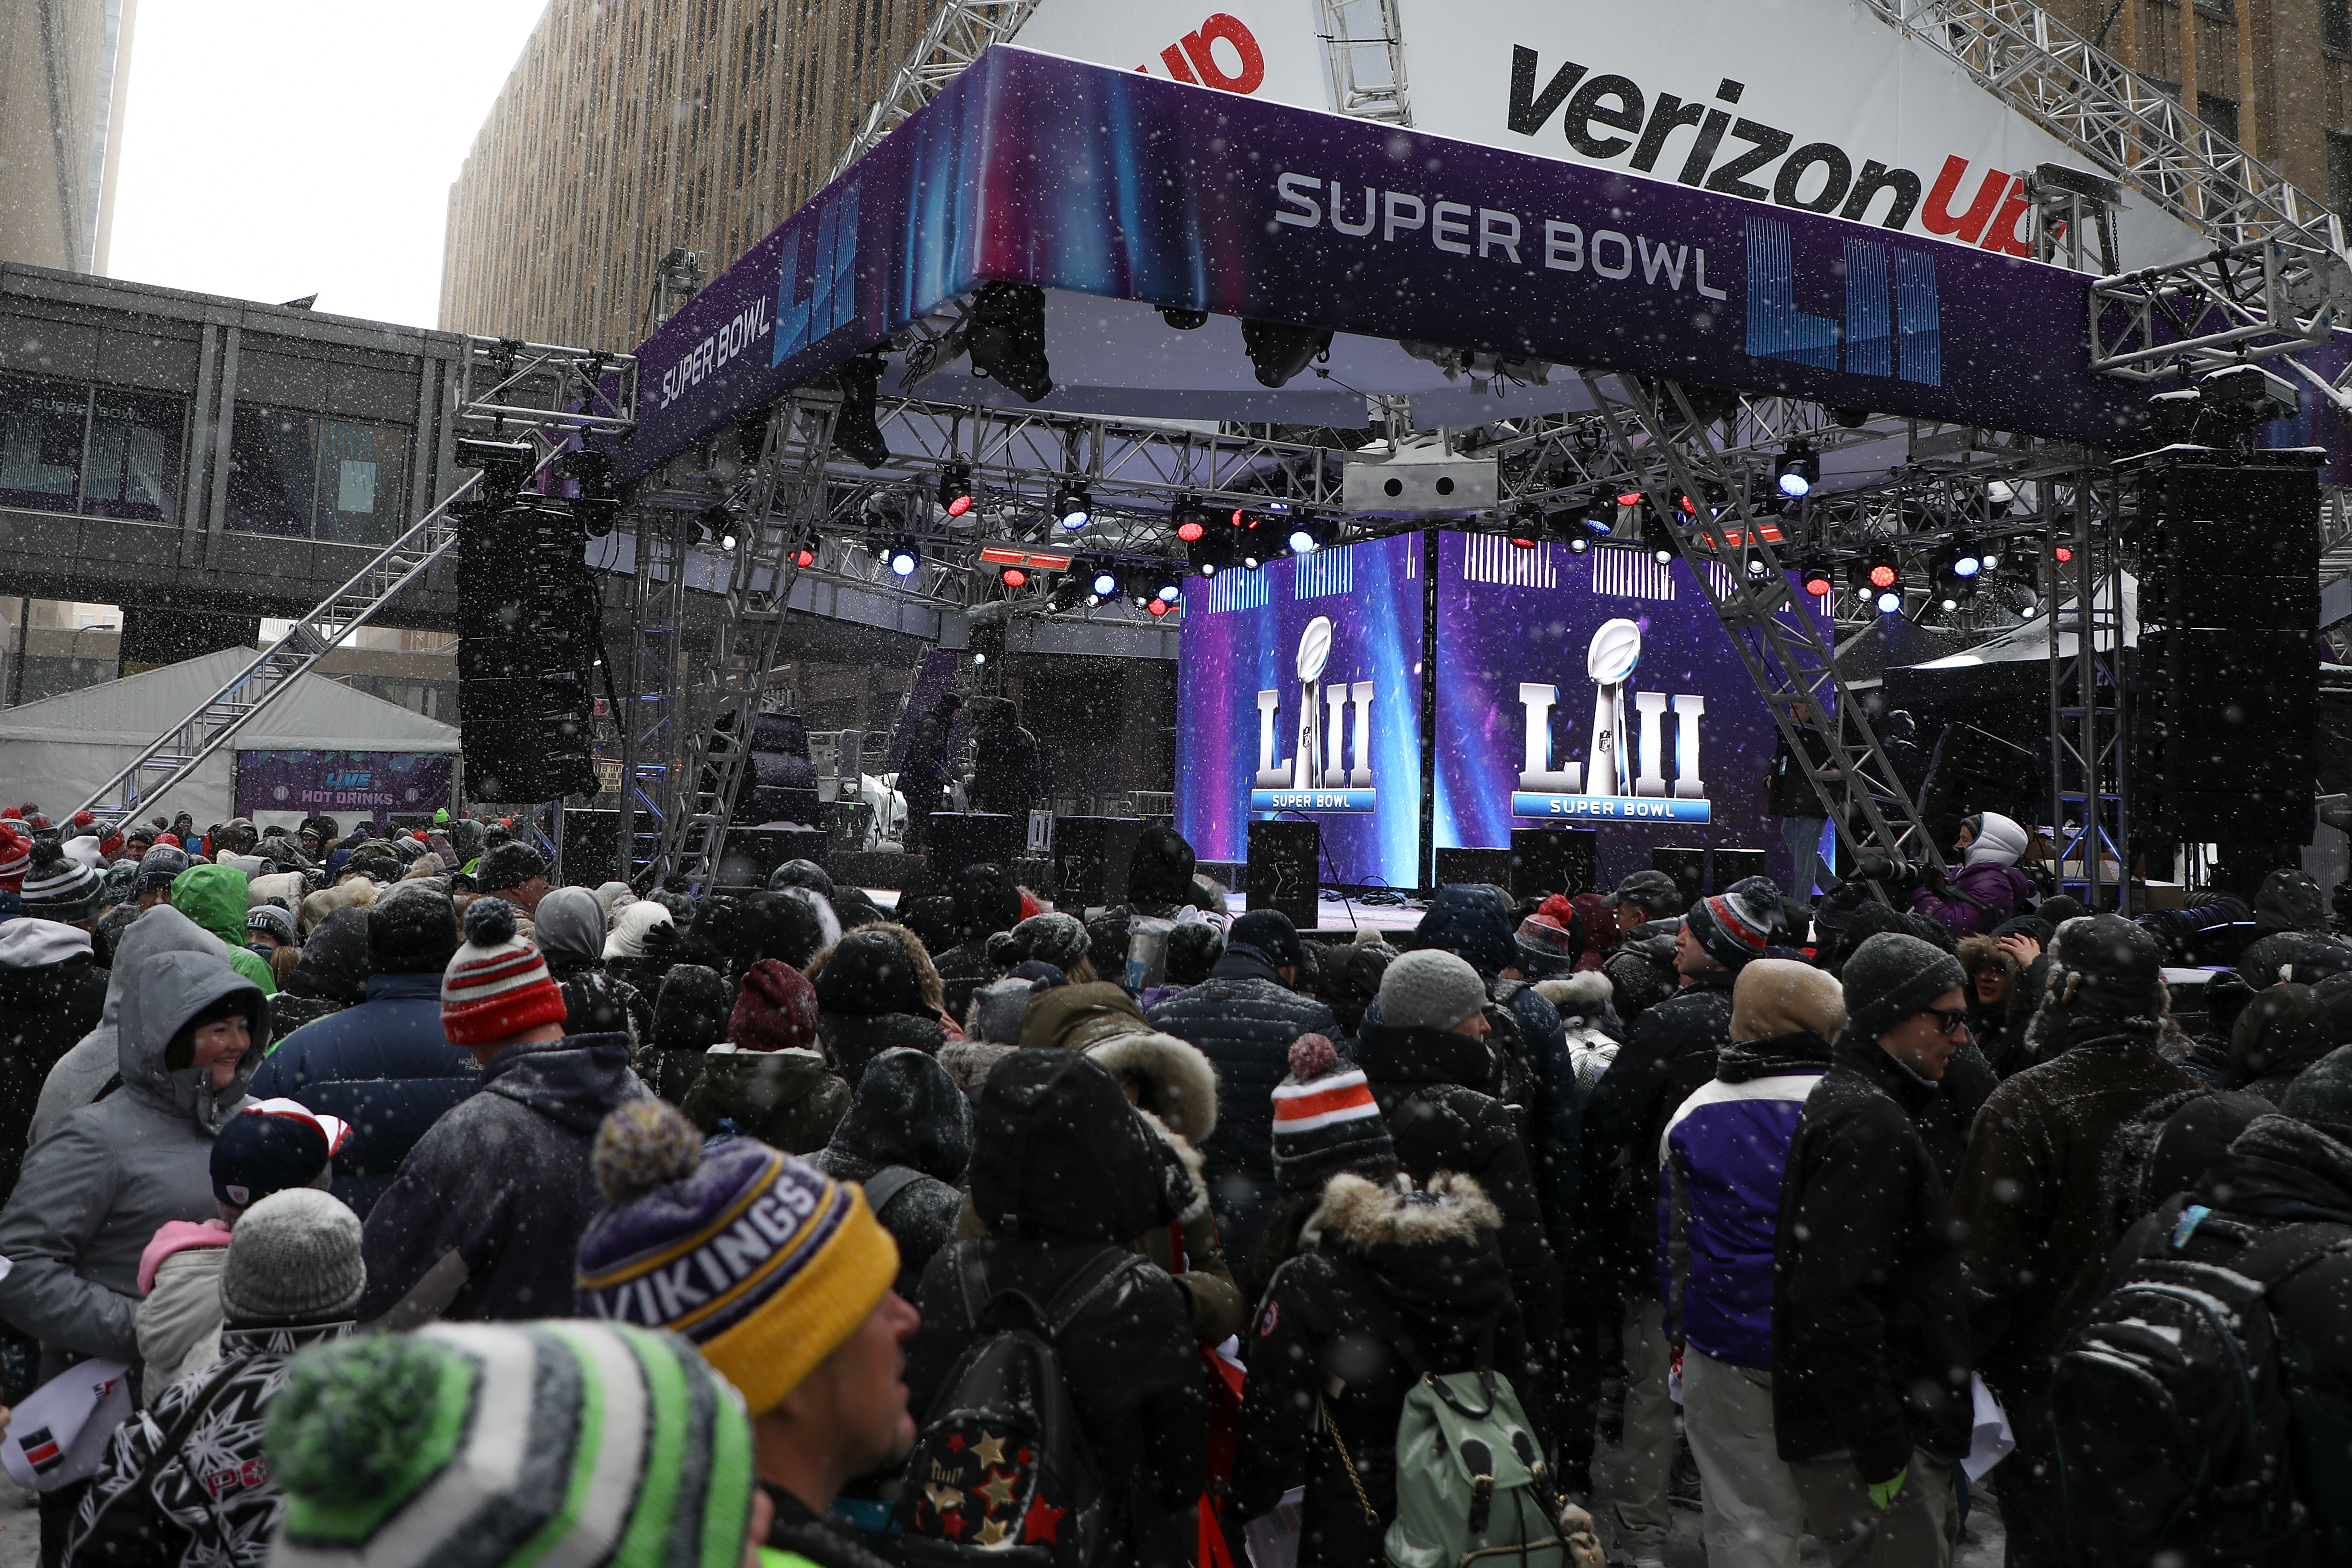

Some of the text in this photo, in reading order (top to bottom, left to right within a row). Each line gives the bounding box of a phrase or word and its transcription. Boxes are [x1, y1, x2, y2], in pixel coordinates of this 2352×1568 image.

[660, 176, 862, 410] SUPER BOWL LII
[1275, 171, 1942, 387] SUPER BOWL LII
[32, 398, 146, 422] SUPER BOWL
[1255, 680, 1375, 789] LII
[1518, 682, 1705, 799] LII
[302, 790, 393, 806] HOT DRINKS
[326, 769, 371, 790] LIVE
[1272, 794, 1350, 808] SUPER BOWL
[1550, 799, 1675, 818] SUPER BOWL
[655, 1058, 664, 1097] HELLO
[593, 1174, 818, 1327] VIKINGS
